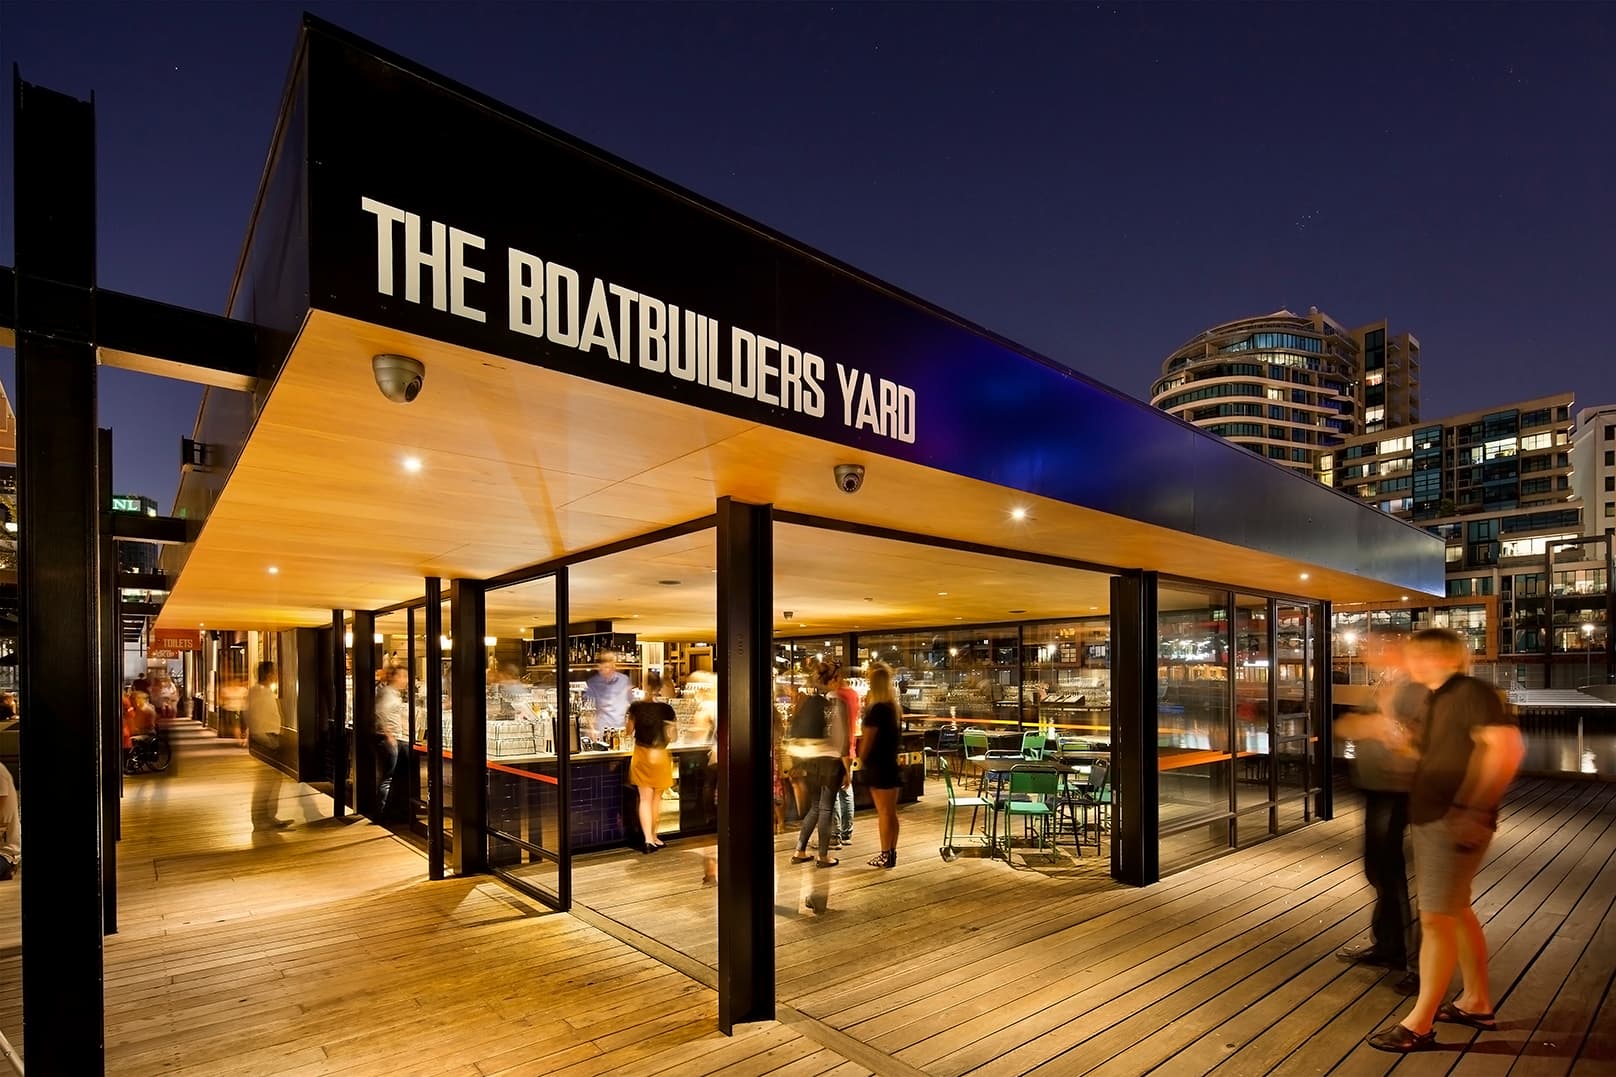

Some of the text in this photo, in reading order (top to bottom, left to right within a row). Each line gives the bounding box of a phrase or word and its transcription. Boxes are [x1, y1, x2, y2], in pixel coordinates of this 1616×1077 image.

[361, 196, 916, 444] THE BOATBUILDERS YARD
[163, 638, 193, 648] TOILETS
